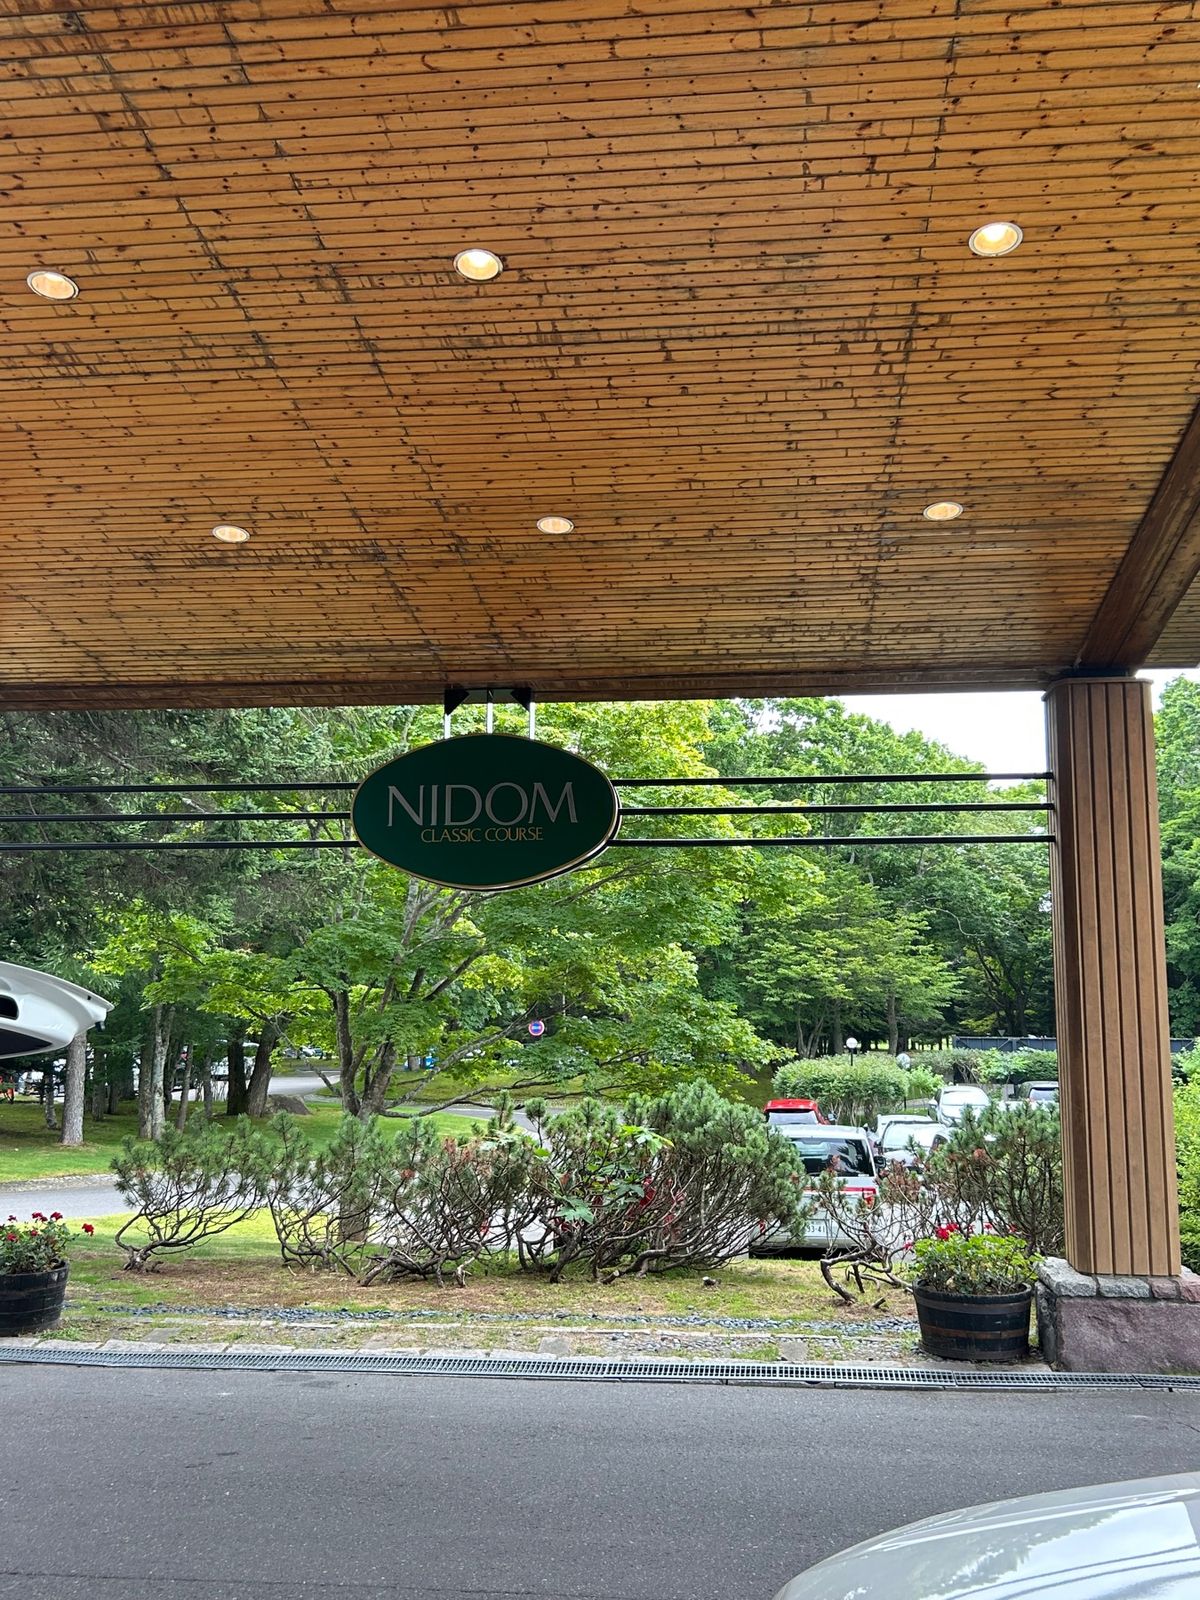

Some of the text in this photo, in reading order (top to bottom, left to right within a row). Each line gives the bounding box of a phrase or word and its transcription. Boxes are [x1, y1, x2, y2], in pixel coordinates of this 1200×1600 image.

[387, 782, 578, 827] NIDOM
[420, 827, 544, 843] CLASSIC COURSE
